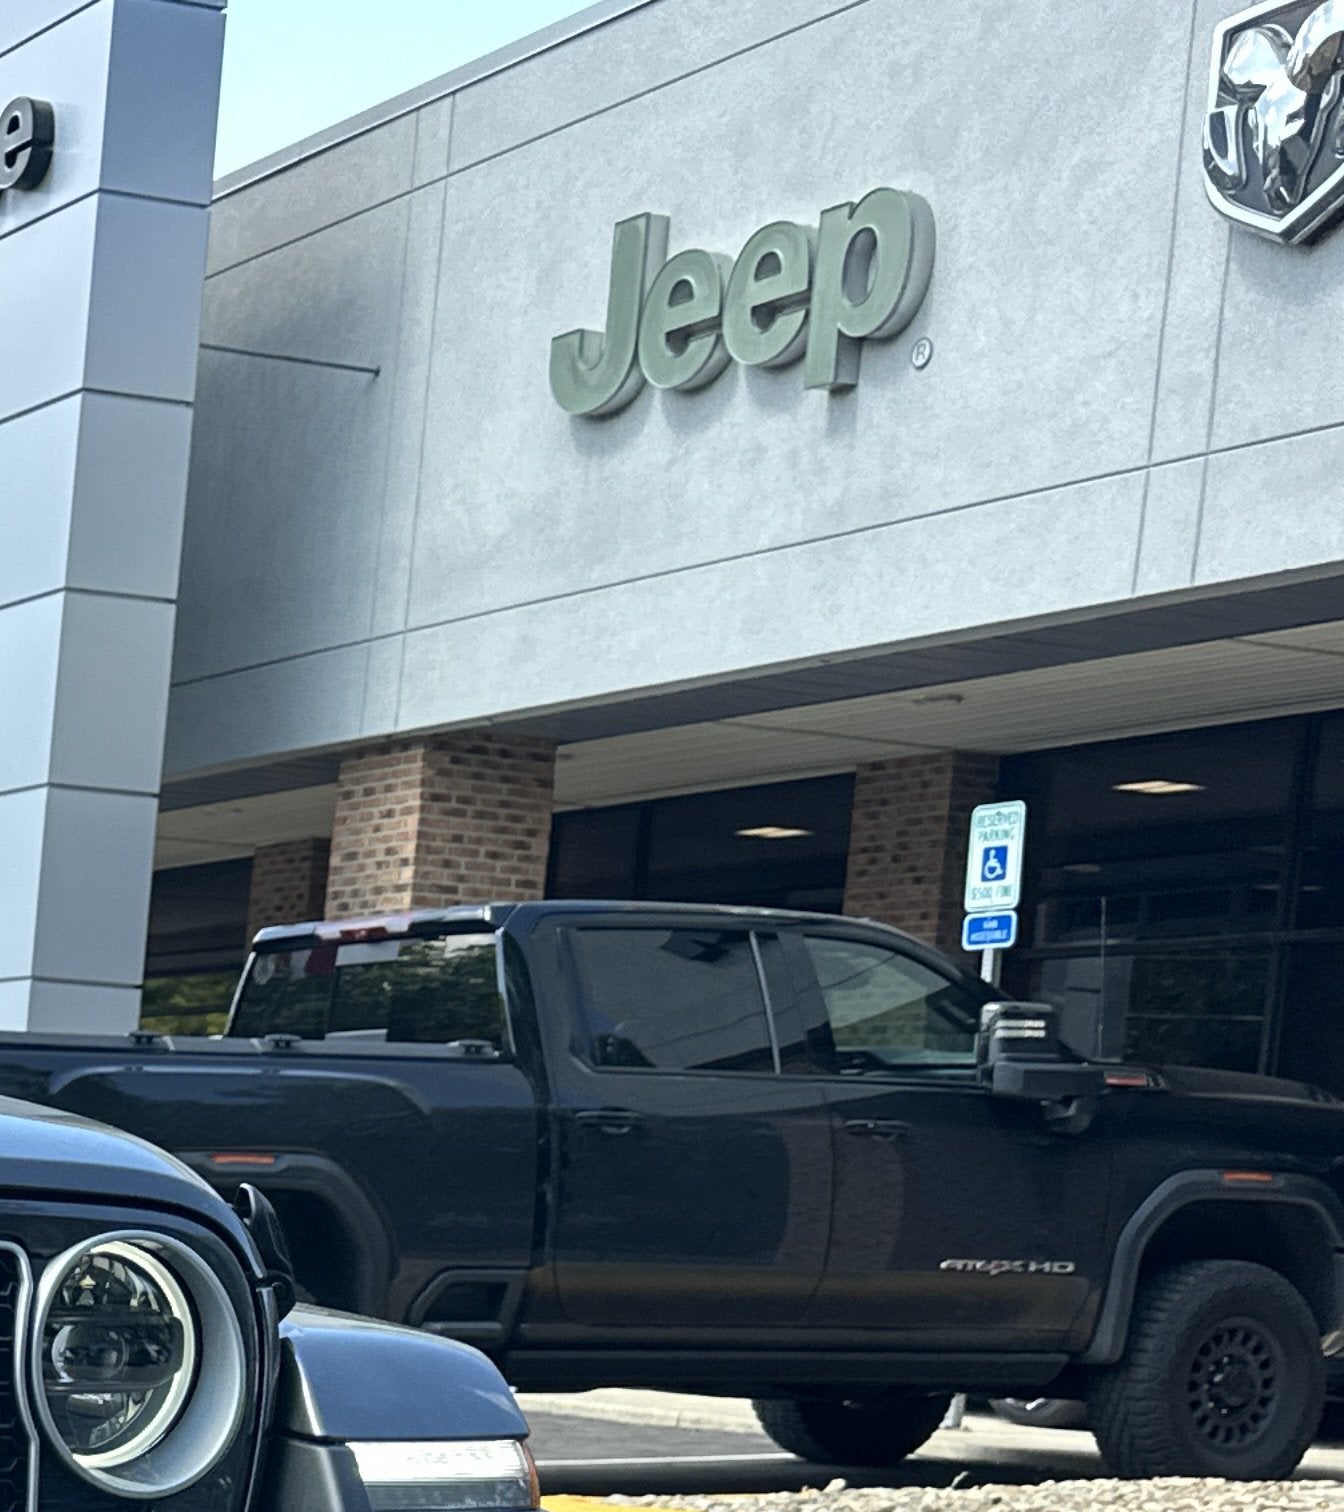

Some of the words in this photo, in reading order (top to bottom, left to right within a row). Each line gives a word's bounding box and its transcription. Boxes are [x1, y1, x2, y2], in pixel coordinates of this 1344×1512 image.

[549, 187, 936, 418] Jeep
[977, 827, 1015, 842] PARKING
[1028, 1260, 1075, 1274] HD
